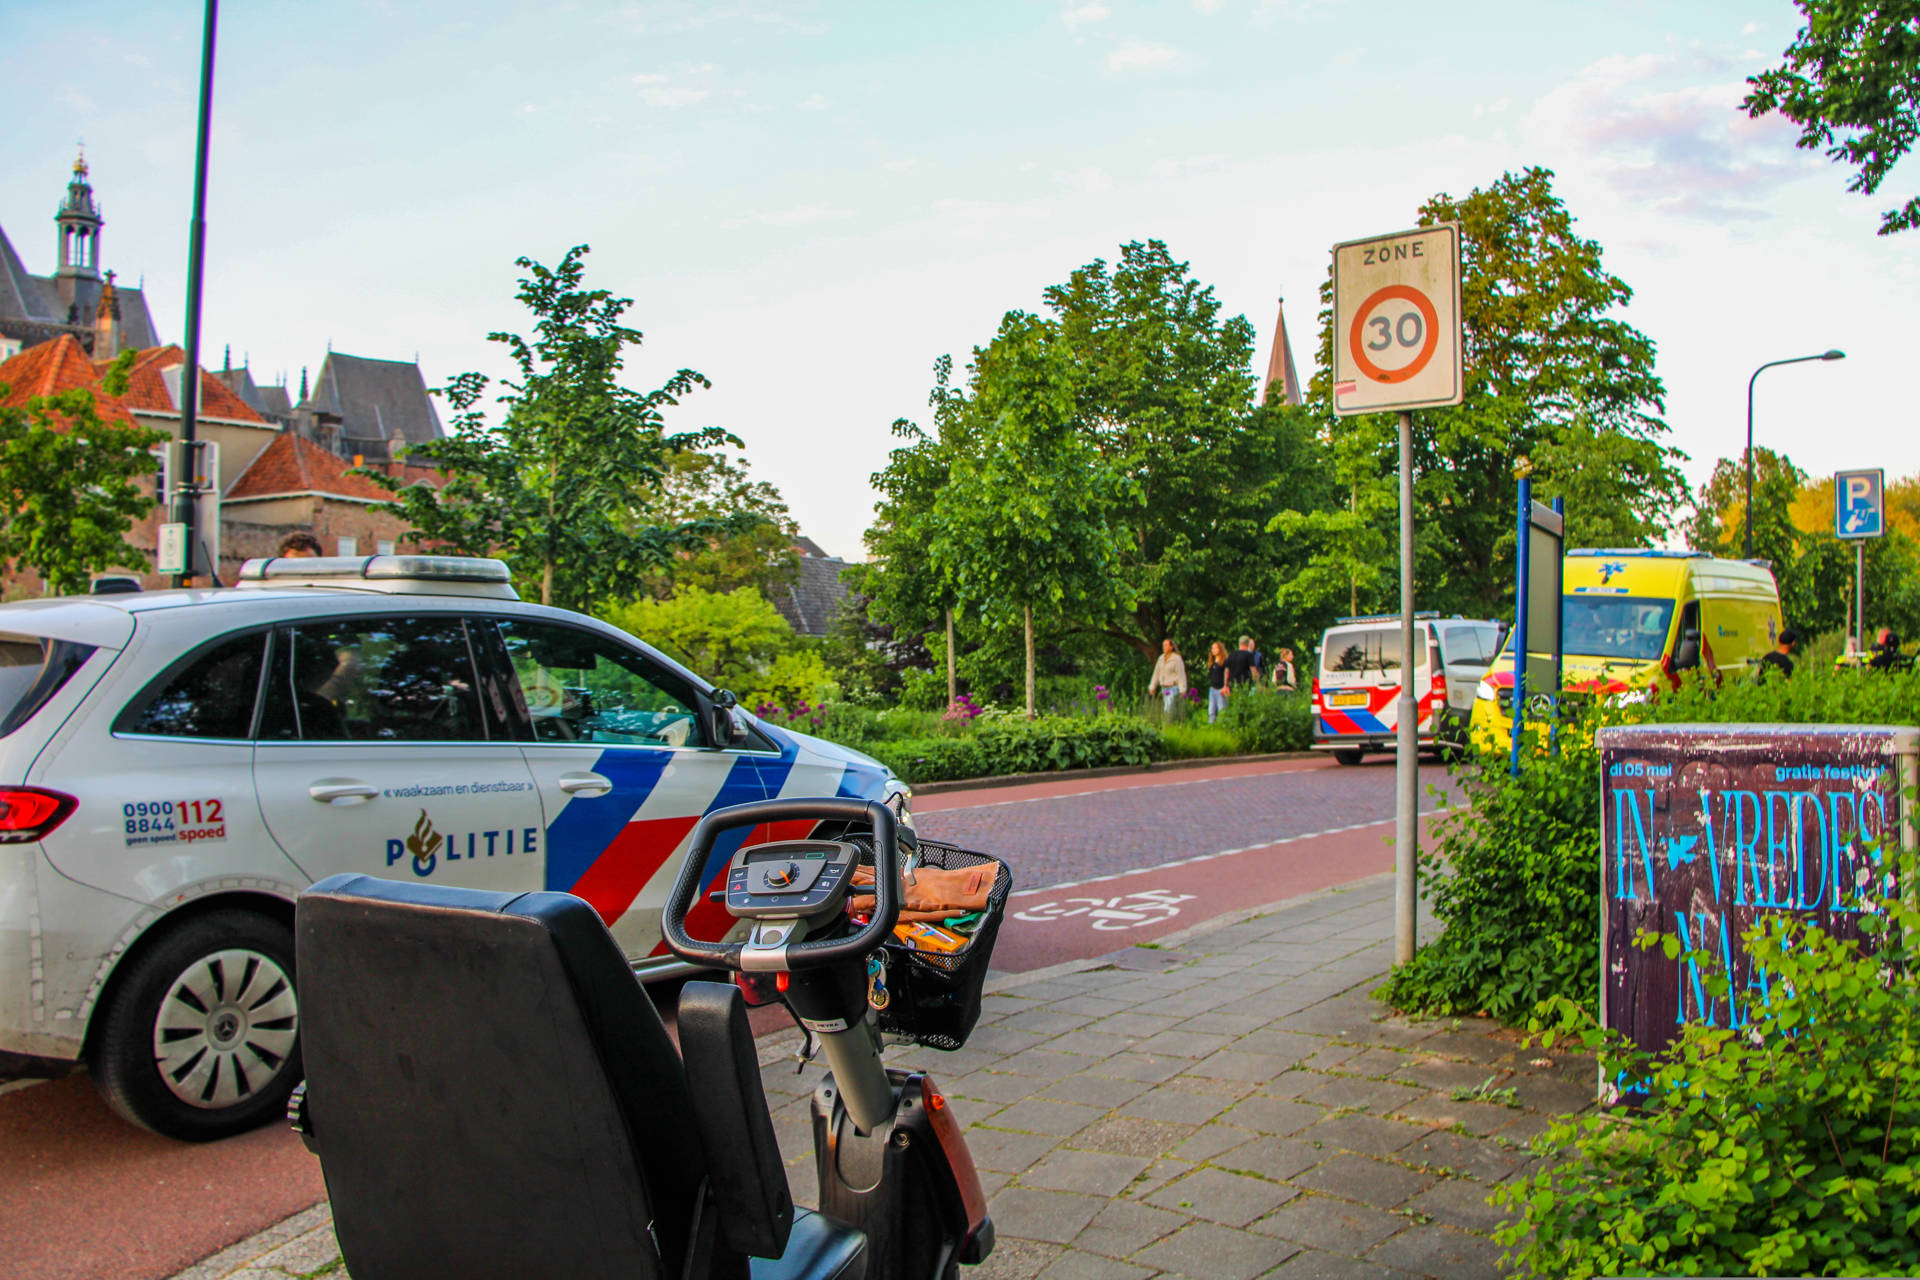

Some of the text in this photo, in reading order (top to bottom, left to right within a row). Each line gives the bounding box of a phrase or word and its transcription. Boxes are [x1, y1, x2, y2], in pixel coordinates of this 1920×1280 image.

[1364, 241, 1424, 265] ZONE
[1367, 312, 1423, 351] 30
[1846, 477, 1872, 511] P
[1609, 762, 1623, 777] di
[1624, 763, 1644, 777] 05
[1775, 763, 1821, 782] gratis
[392, 784, 454, 798] waakzaam
[455, 784, 470, 795] en
[470, 780, 525, 794] dienstbaar
[123, 801, 174, 817] 0900
[176, 798, 224, 825] 112
[125, 817, 175, 834] 8844
[178, 824, 225, 844] spoed
[386, 827, 538, 877] POLITIE
[1612, 788, 1891, 916] IN VREDES
[1674, 910, 1819, 1040] NAA
